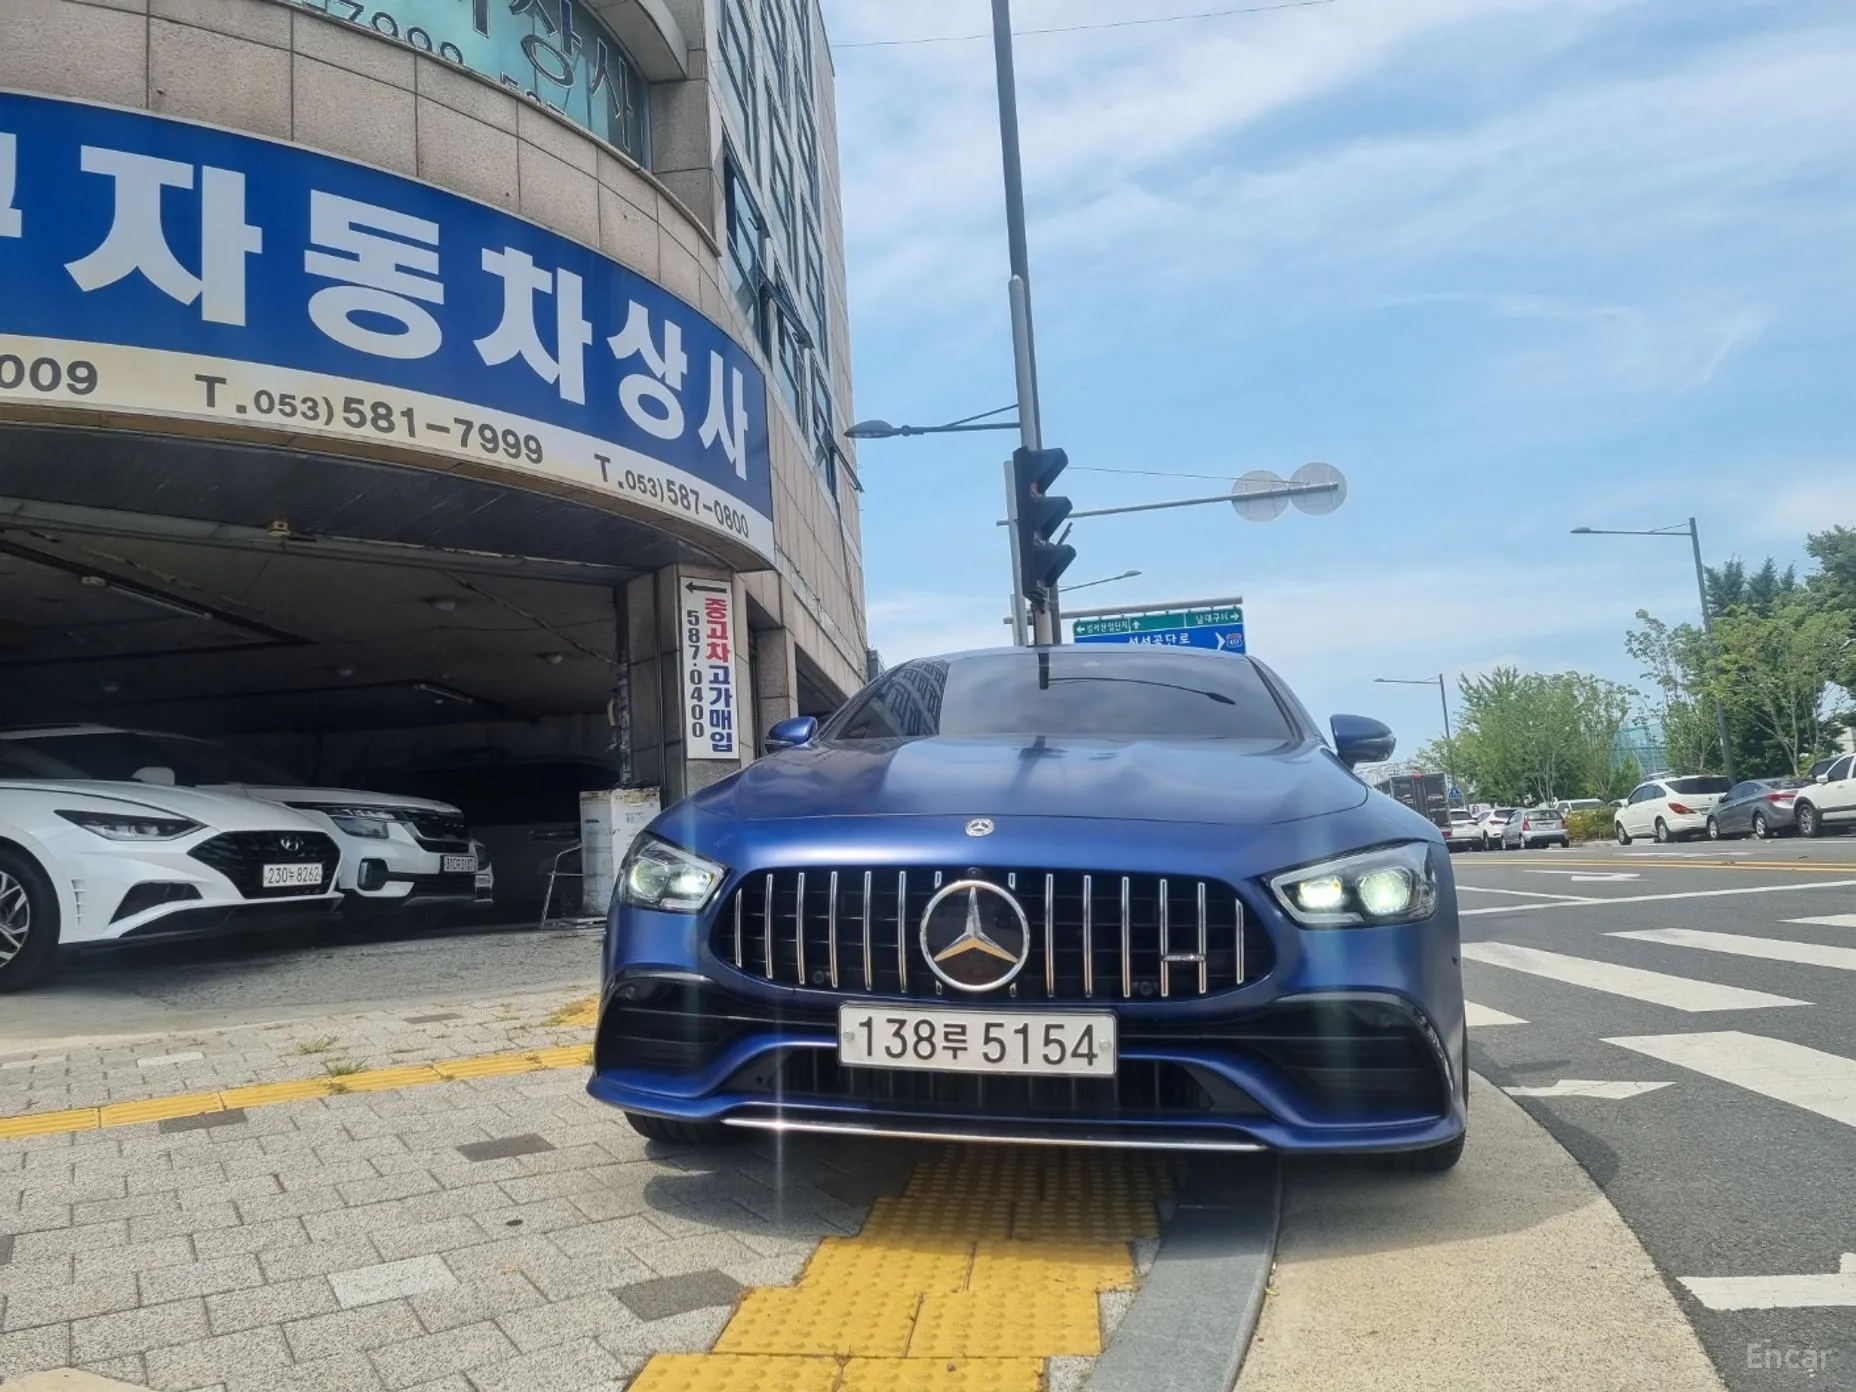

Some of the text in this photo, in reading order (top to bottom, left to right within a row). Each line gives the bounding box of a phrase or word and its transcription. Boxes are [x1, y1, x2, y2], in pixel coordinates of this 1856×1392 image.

[0, 132, 748, 481] 자동차상사
[705, 598, 733, 752] 중고차 고가매입
